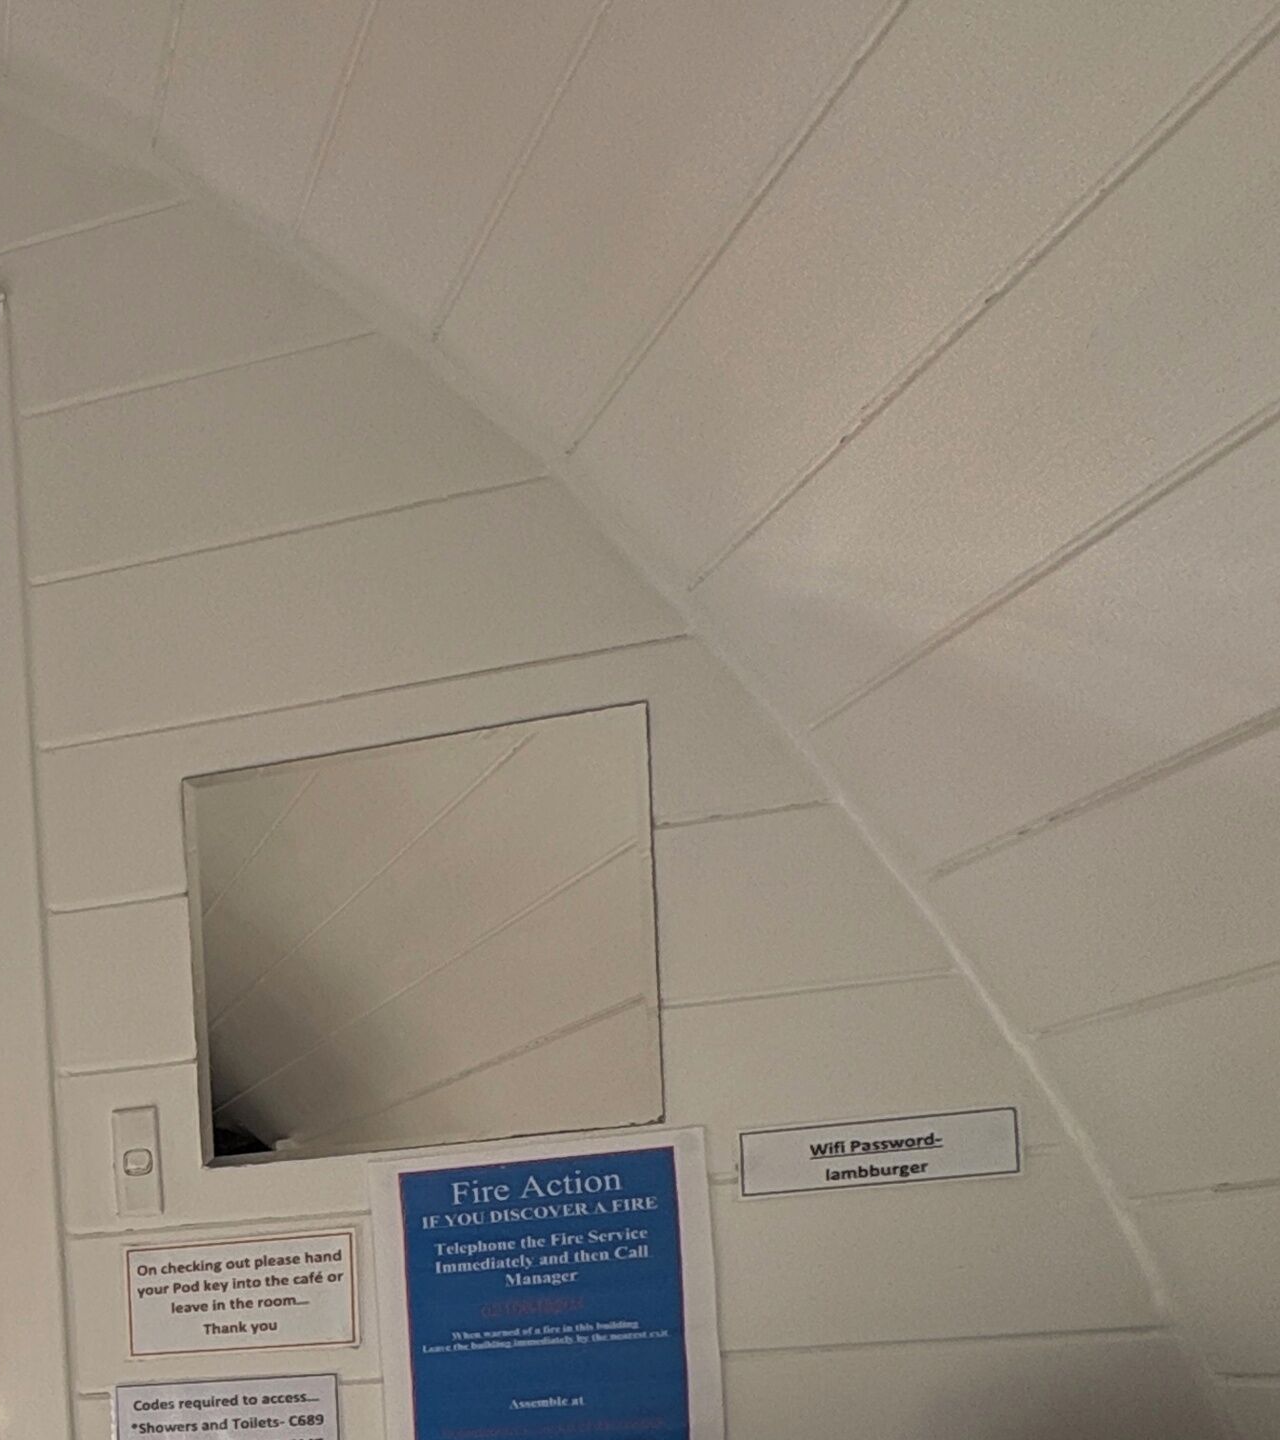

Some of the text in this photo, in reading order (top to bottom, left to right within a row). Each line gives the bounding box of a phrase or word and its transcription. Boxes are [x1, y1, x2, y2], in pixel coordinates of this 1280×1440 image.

[809, 1132, 943, 1157] Wifi Password-
[826, 1161, 929, 1182] lambburger
[451, 1169, 622, 1206] Fire Action
[422, 1196, 659, 1230] IF YOU DISCOVER A FIRE
[434, 1228, 649, 1257] Telephone the Fire Service
[136, 1249, 343, 1277] On checking out please hand
[435, 1245, 649, 1274] Immediately and then Call
[136, 1270, 345, 1299] your Pod key into the café or
[505, 1271, 579, 1288] Manager
[170, 1300, 209, 1314] leave
[212, 1298, 226, 1311] in
[229, 1296, 254, 1310] the
[203, 1320, 278, 1336] Thank you
[452, 1331, 481, 1341] When
[483, 1328, 521, 1339] warned
[542, 1324, 561, 1335] fire
[562, 1324, 574, 1334] in
[575, 1322, 594, 1333] this
[422, 1343, 451, 1354] Leave
[453, 1342, 470, 1352] the
[470, 1339, 512, 1351] building
[513, 1334, 574, 1348] immediately
[576, 1333, 590, 1345] by
[591, 1331, 609, 1342] the
[609, 1329, 648, 1341] nearest
[133, 1399, 175, 1412] Codes
[178, 1394, 239, 1411] required
[242, 1394, 258, 1406] to
[509, 1396, 585, 1410] Assemble at
[201, 1418, 228, 1431] and
[288, 1413, 325, 1428] C689
